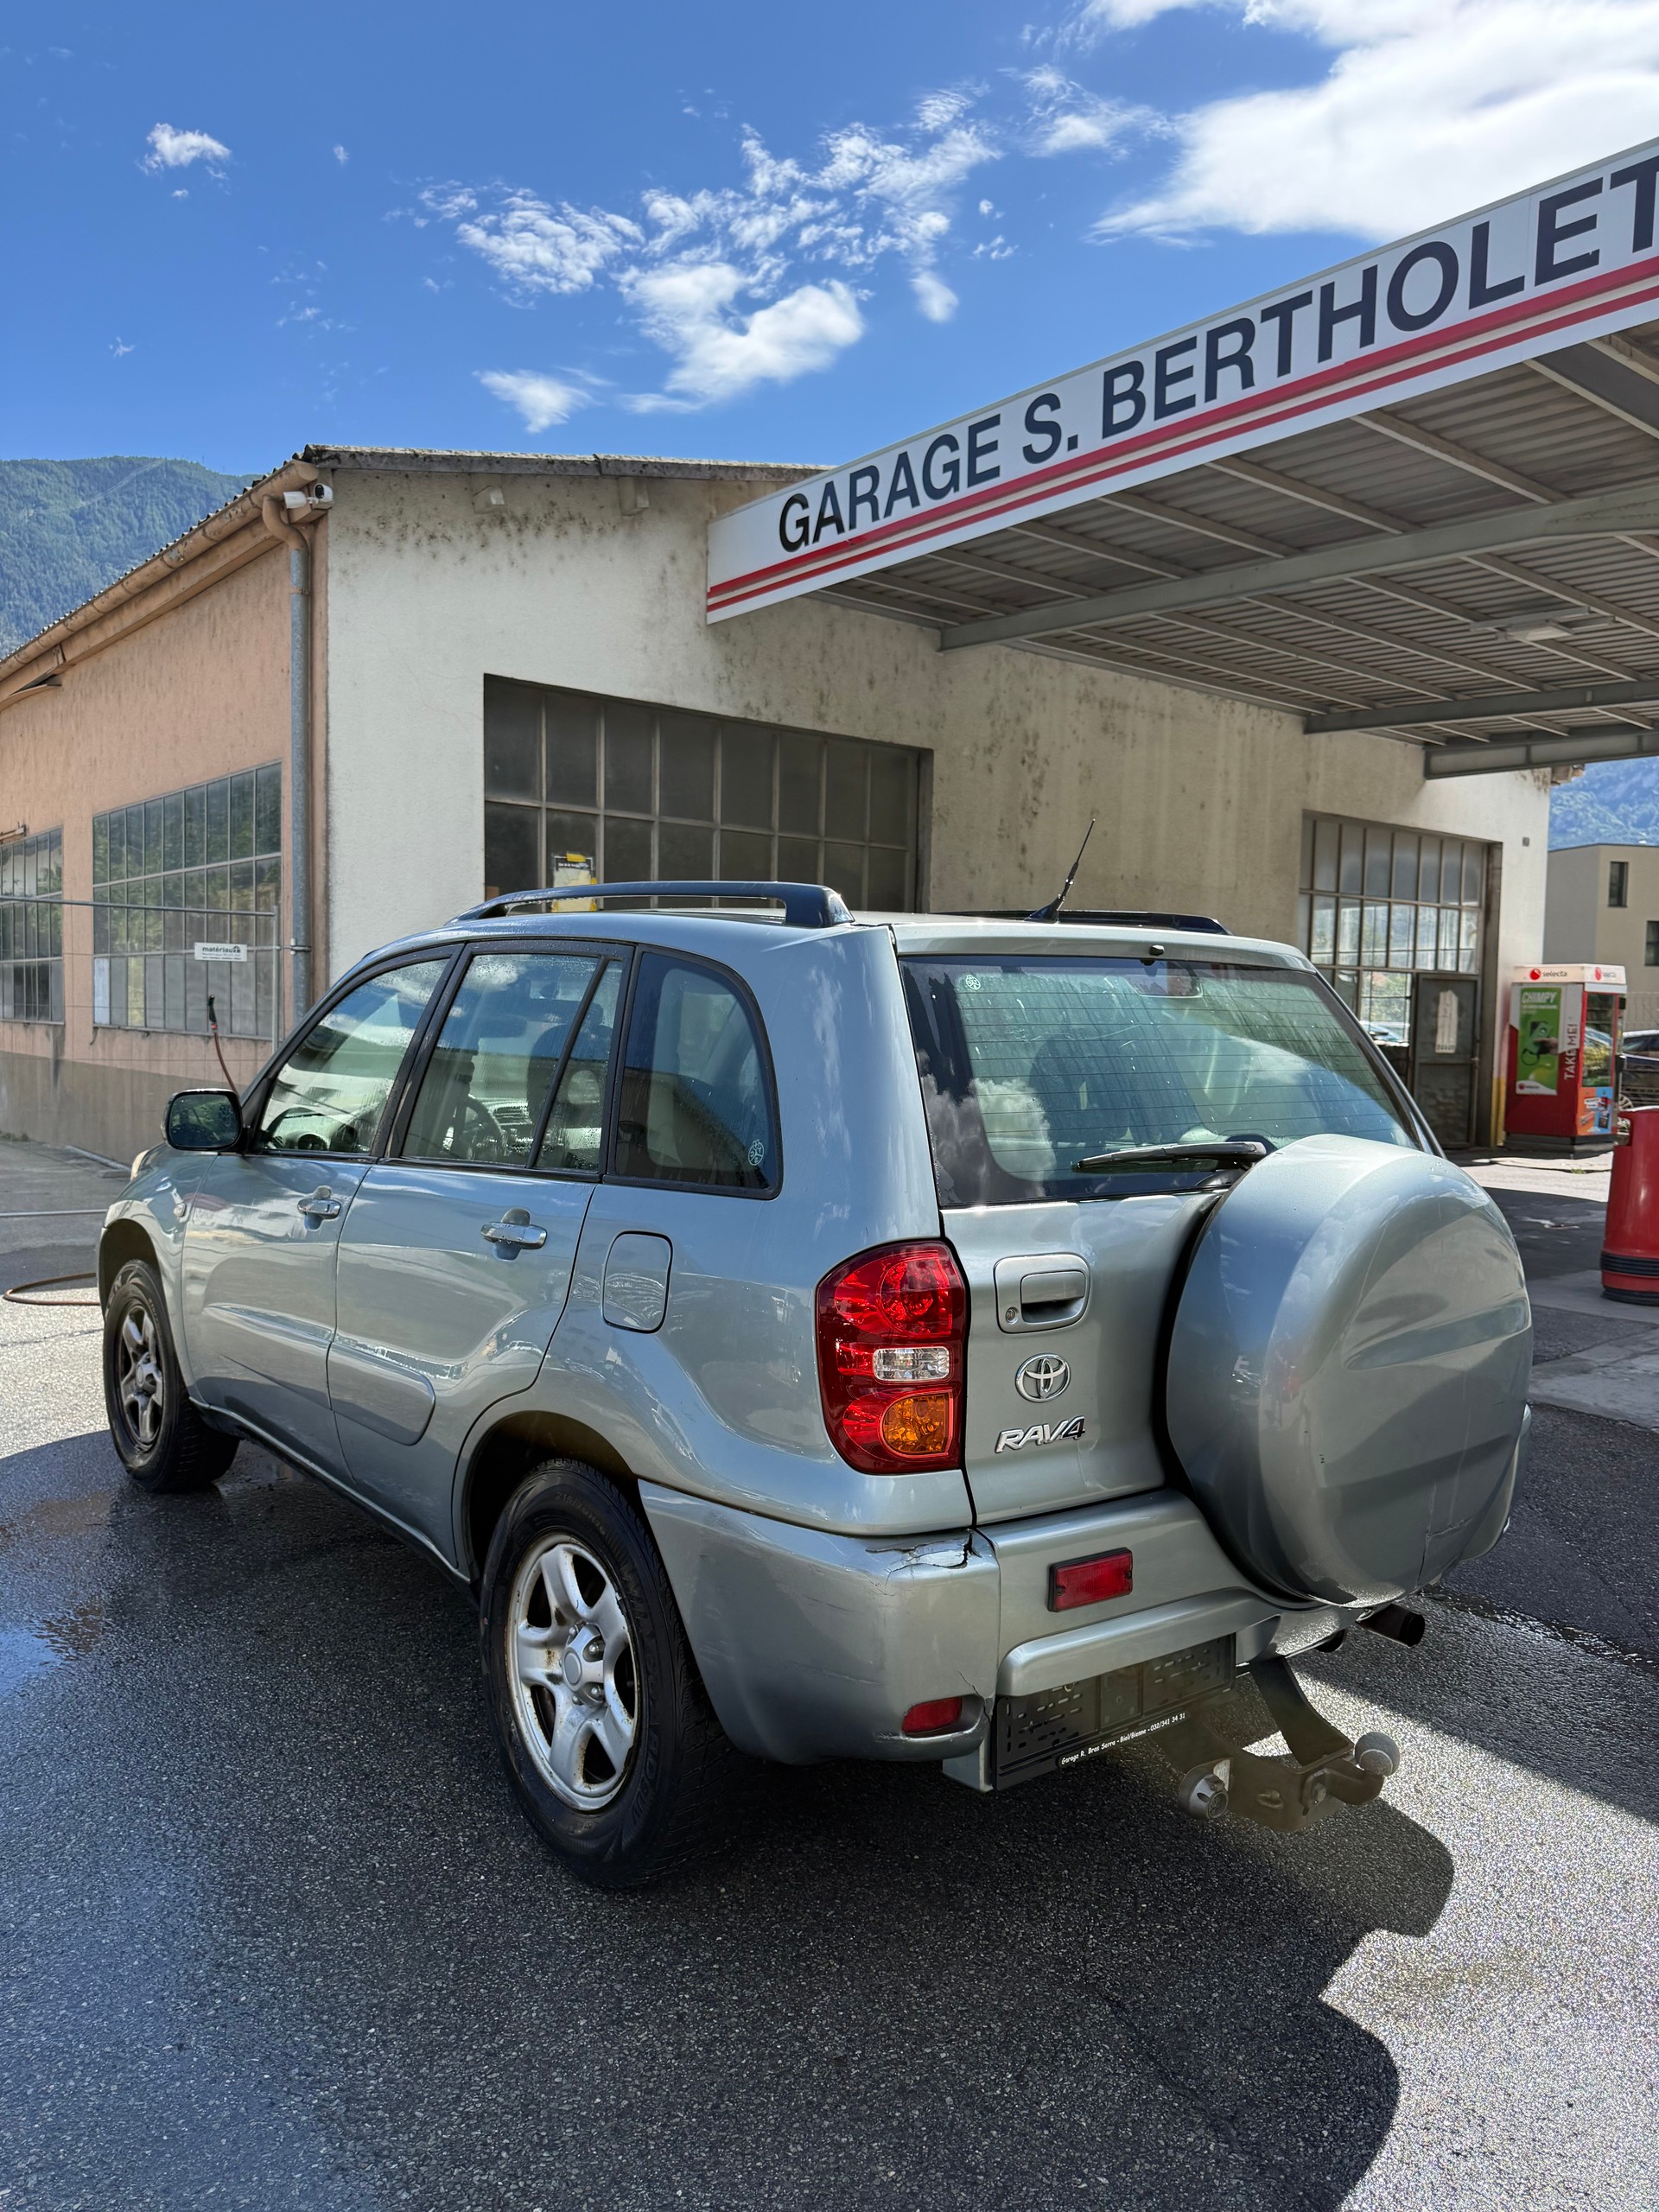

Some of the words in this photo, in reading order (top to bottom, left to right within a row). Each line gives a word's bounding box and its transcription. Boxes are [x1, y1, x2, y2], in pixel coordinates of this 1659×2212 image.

[779, 414, 1001, 553] GARAGE
[1022, 392, 1078, 464] S.
[1102, 156, 1659, 439] BERTHOLET
[1522, 991, 1557, 1004] CHIMPY
[1566, 1023, 1578, 1046] ME!
[1564, 1048, 1577, 1080] TAKE
[995, 1414, 1086, 1454] RAV4
[1061, 1753, 1079, 1765] Garage
[1088, 1745, 1099, 1755] Bras
[1101, 1739, 1116, 1750] Serra
[1120, 1728, 1147, 1743] Biel/Bienne
[1150, 1719, 1170, 1732] 032/341
